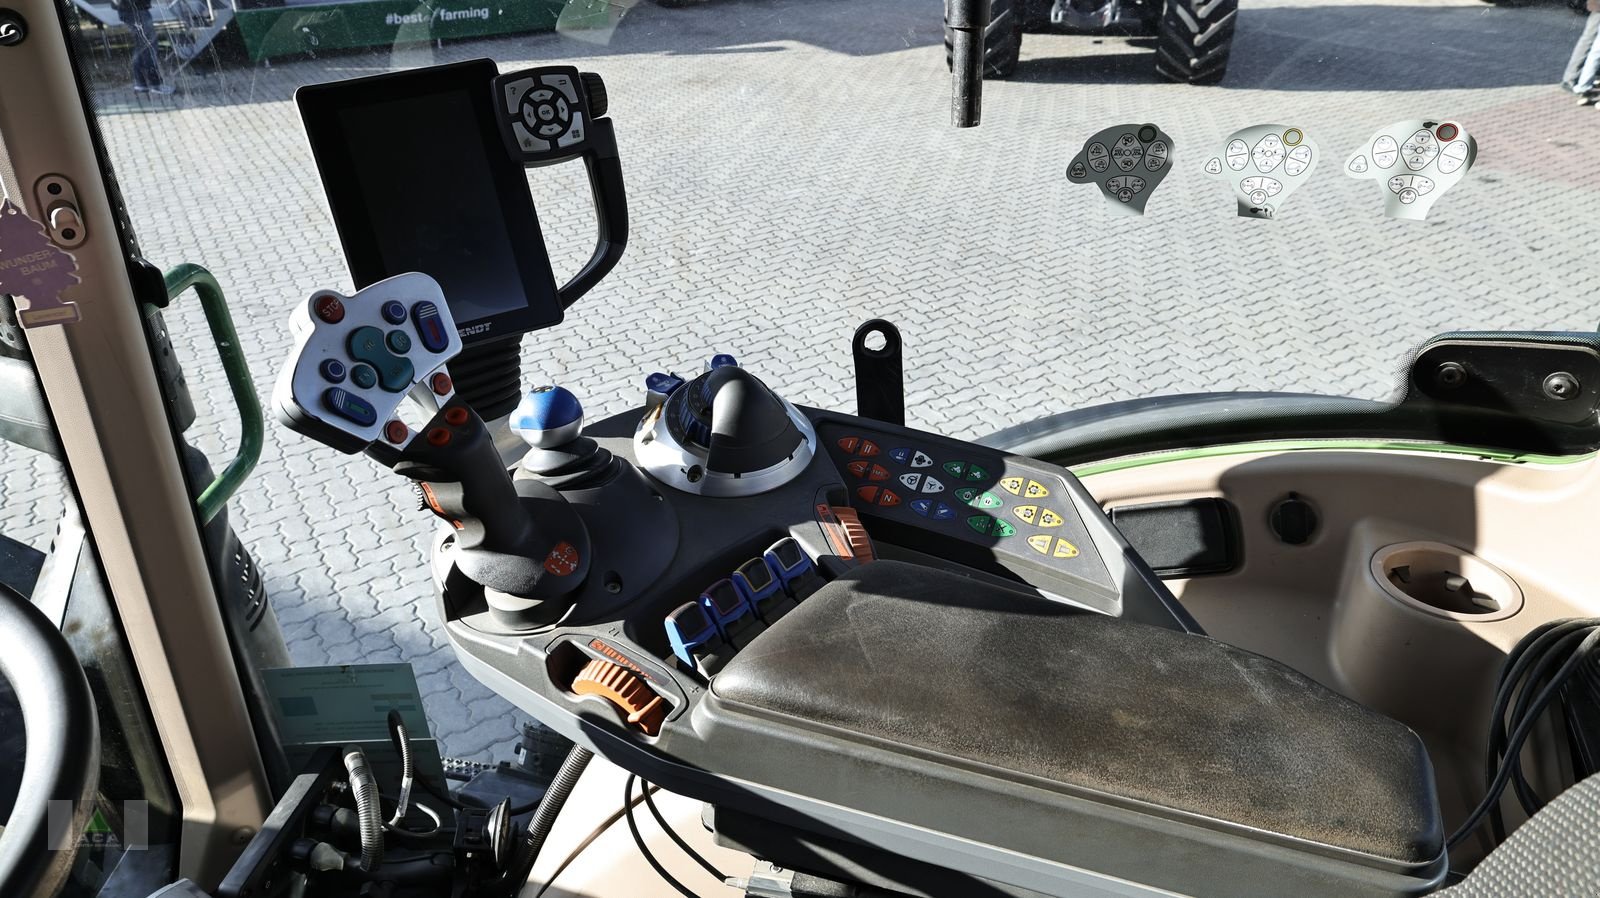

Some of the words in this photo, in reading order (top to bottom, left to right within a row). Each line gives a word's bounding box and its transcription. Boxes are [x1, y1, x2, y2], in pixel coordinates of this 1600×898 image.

[385, 12, 422, 25] #best
[440, 7, 489, 21] farming
[21, 259, 58, 276] BAUM
[322, 299, 340, 317] STOP
[459, 321, 492, 338] ENDT
